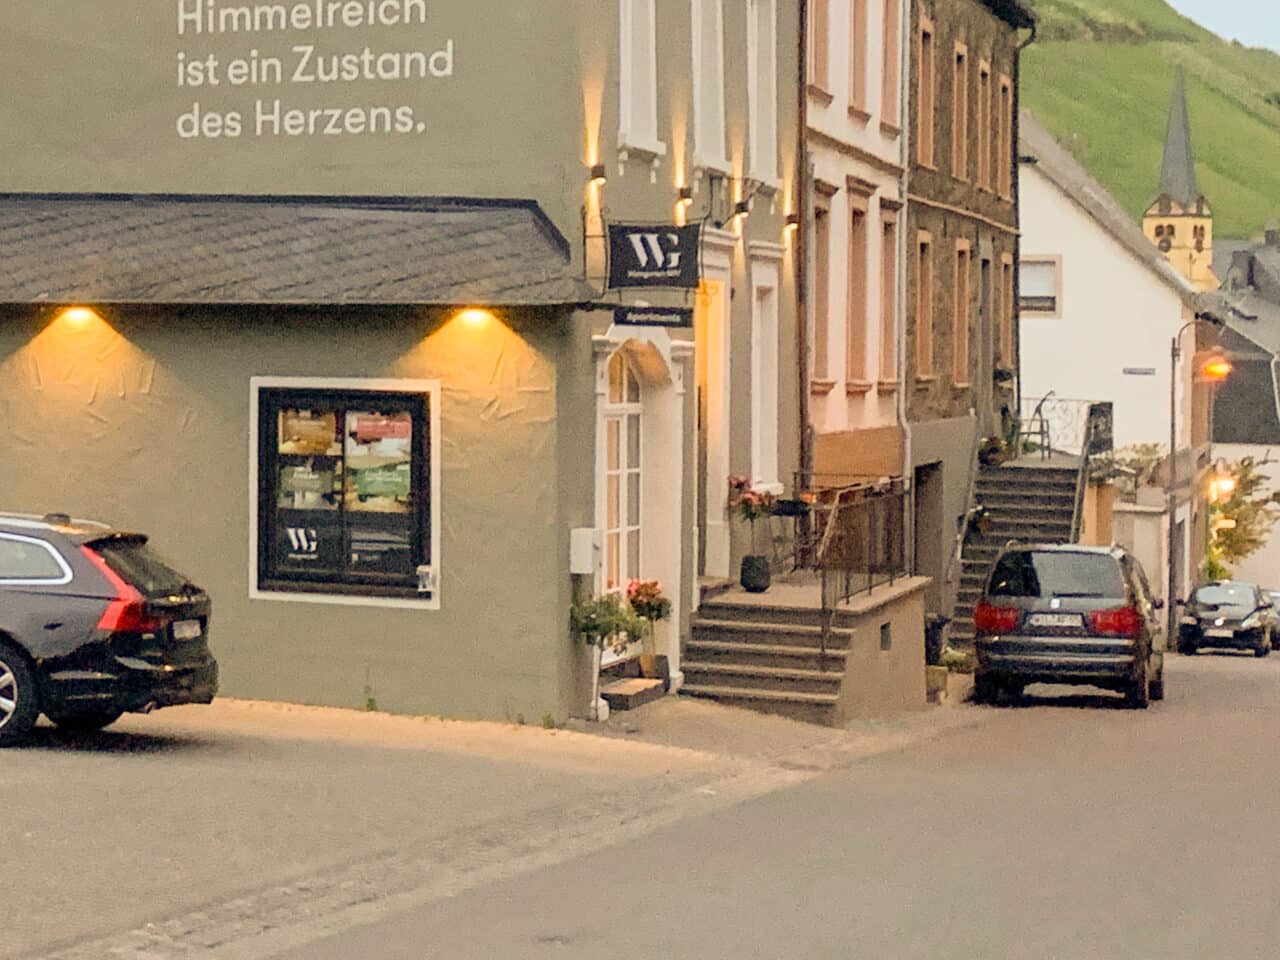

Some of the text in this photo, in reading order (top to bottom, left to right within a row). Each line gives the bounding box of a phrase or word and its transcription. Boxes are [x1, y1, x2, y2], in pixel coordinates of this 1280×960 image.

[177, 40, 453, 86] ist ein Zustand
[176, 99, 426, 138] des Herzens.
